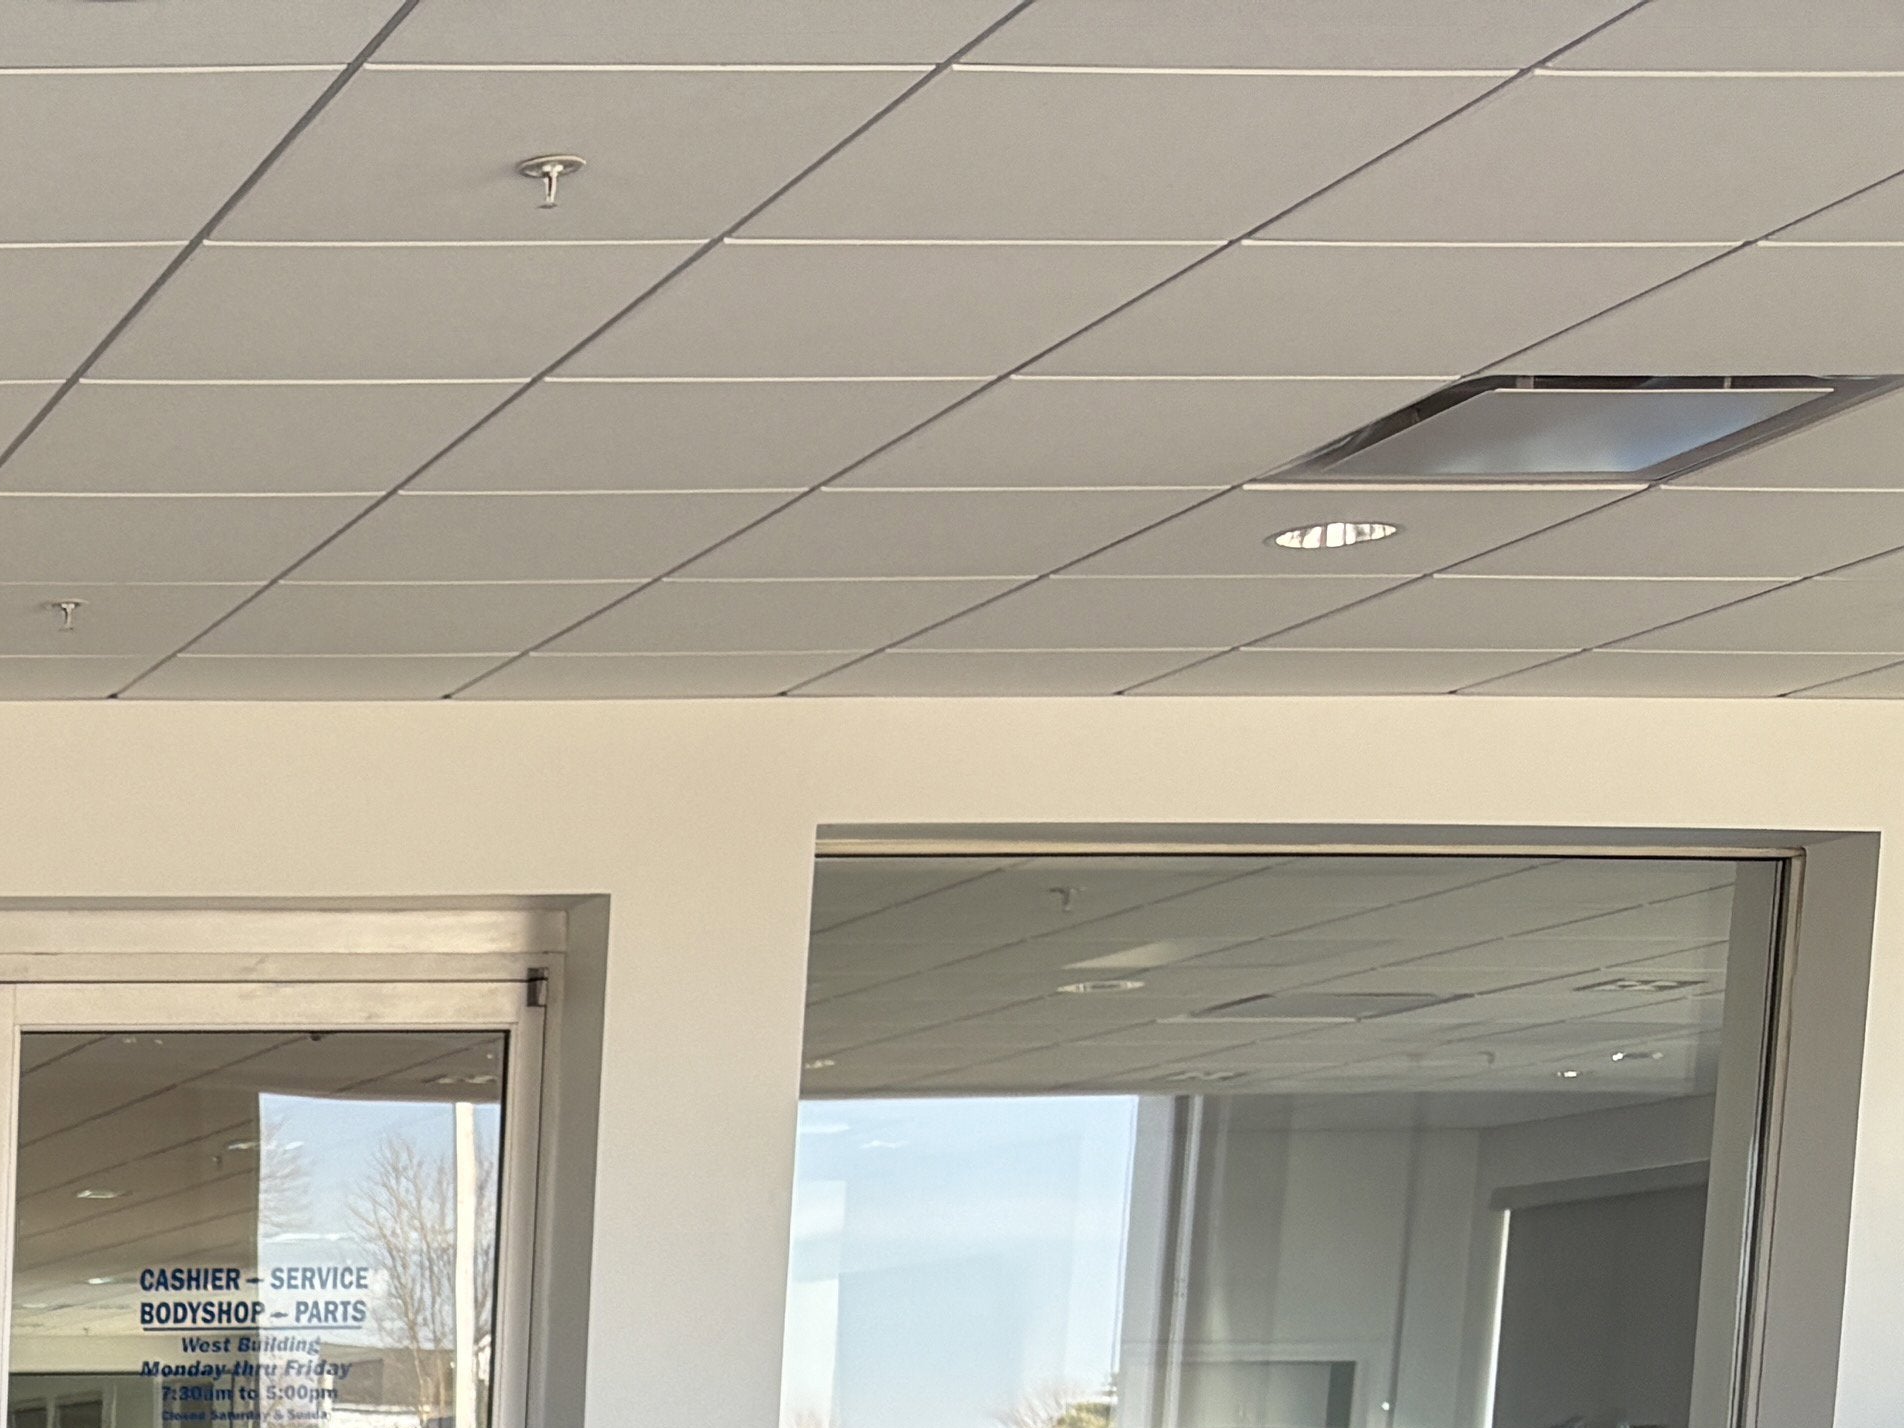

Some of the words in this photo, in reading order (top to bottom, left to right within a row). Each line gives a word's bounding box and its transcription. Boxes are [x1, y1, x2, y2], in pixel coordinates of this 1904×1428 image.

[140, 1268, 240, 1291] CASHIER
[271, 1267, 369, 1289] SERVICE
[141, 1301, 265, 1324] BODYSHOP
[295, 1301, 366, 1323] PARTS
[182, 1337, 230, 1352] West
[238, 1336, 321, 1356] Building
[141, 1361, 227, 1380] Monday
[233, 1361, 276, 1376] thru
[284, 1360, 352, 1379] Friday
[162, 1386, 233, 1401] 7:30am
[239, 1386, 258, 1400] to
[266, 1385, 338, 1403] 5:00pm
